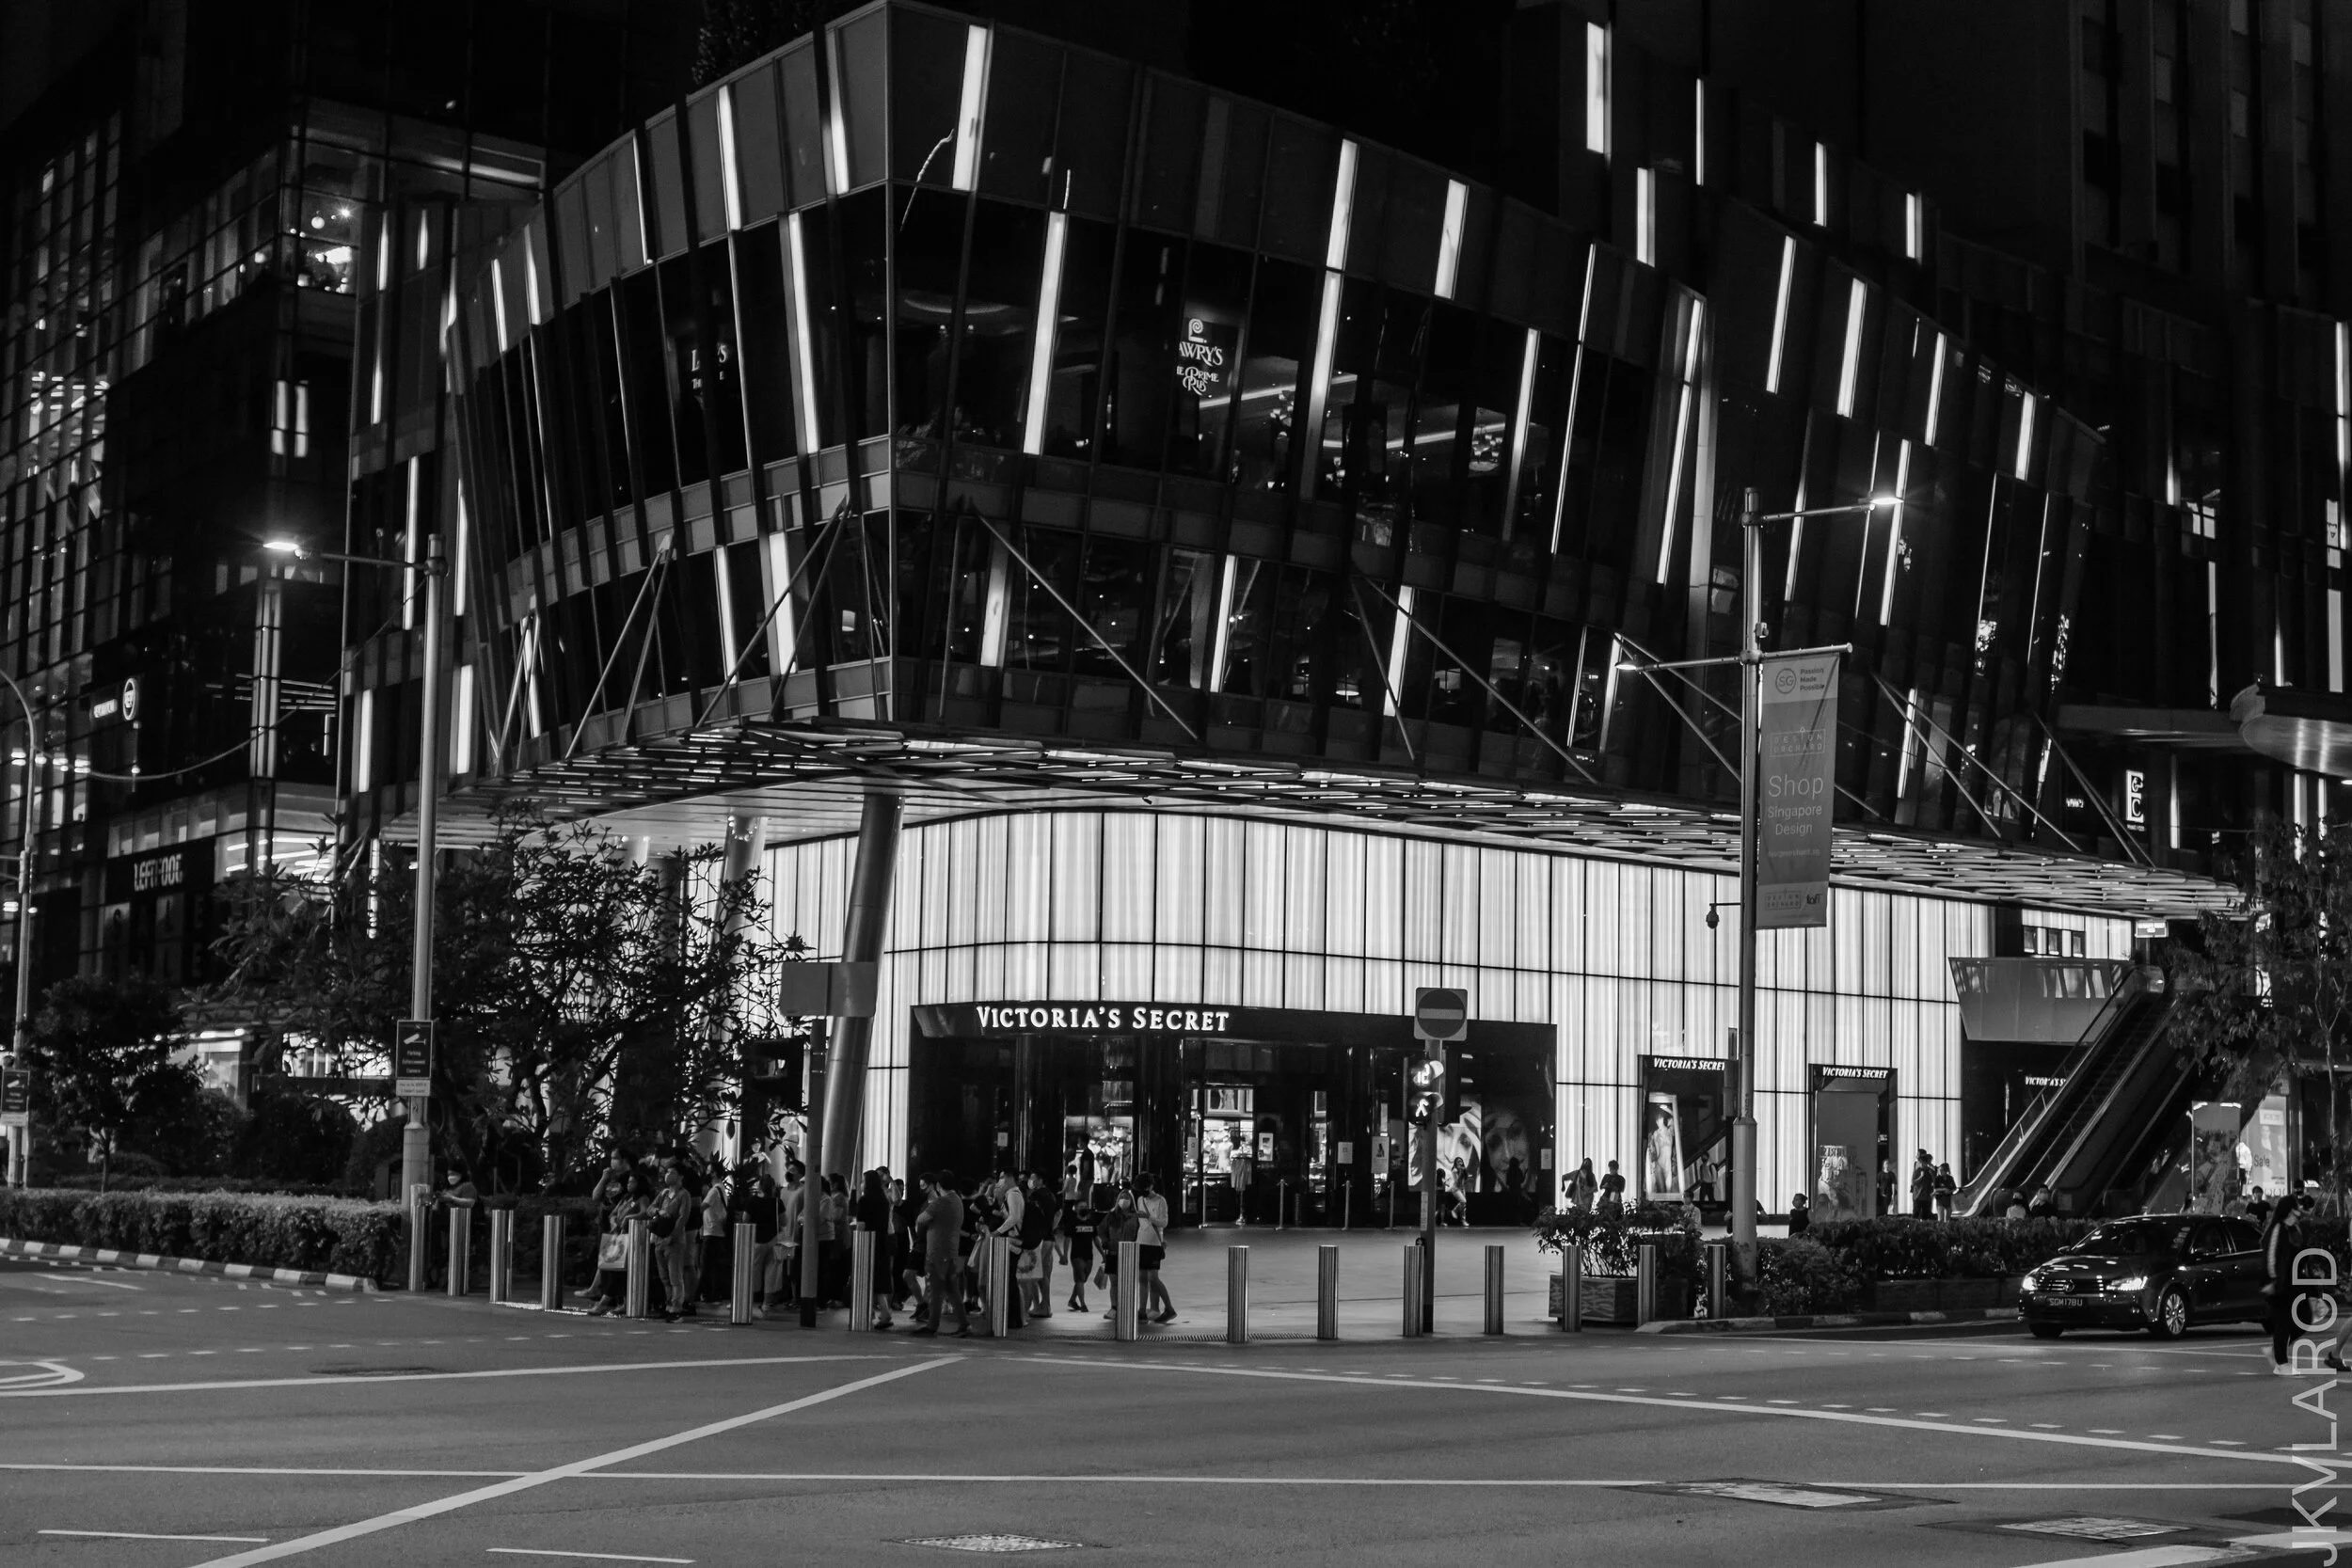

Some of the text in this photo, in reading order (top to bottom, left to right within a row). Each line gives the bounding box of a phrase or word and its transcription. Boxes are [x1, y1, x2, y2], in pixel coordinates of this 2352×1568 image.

[1179, 341, 1223, 366] AWRY'S
[1800, 667, 1824, 675] Passion
[1800, 683, 1825, 692] Possible
[1768, 773, 1824, 800] Shop
[1767, 805, 1822, 820] Singapore
[1775, 823, 1813, 836] Design
[976, 1005, 1231, 1033] VICTORIA'S SECRET
[1653, 1057, 1697, 1070] VICTORIA'S
[1822, 1066, 1889, 1080] VICTORIA'S SECRET
[2253, 1154, 2270, 1167] Sale
